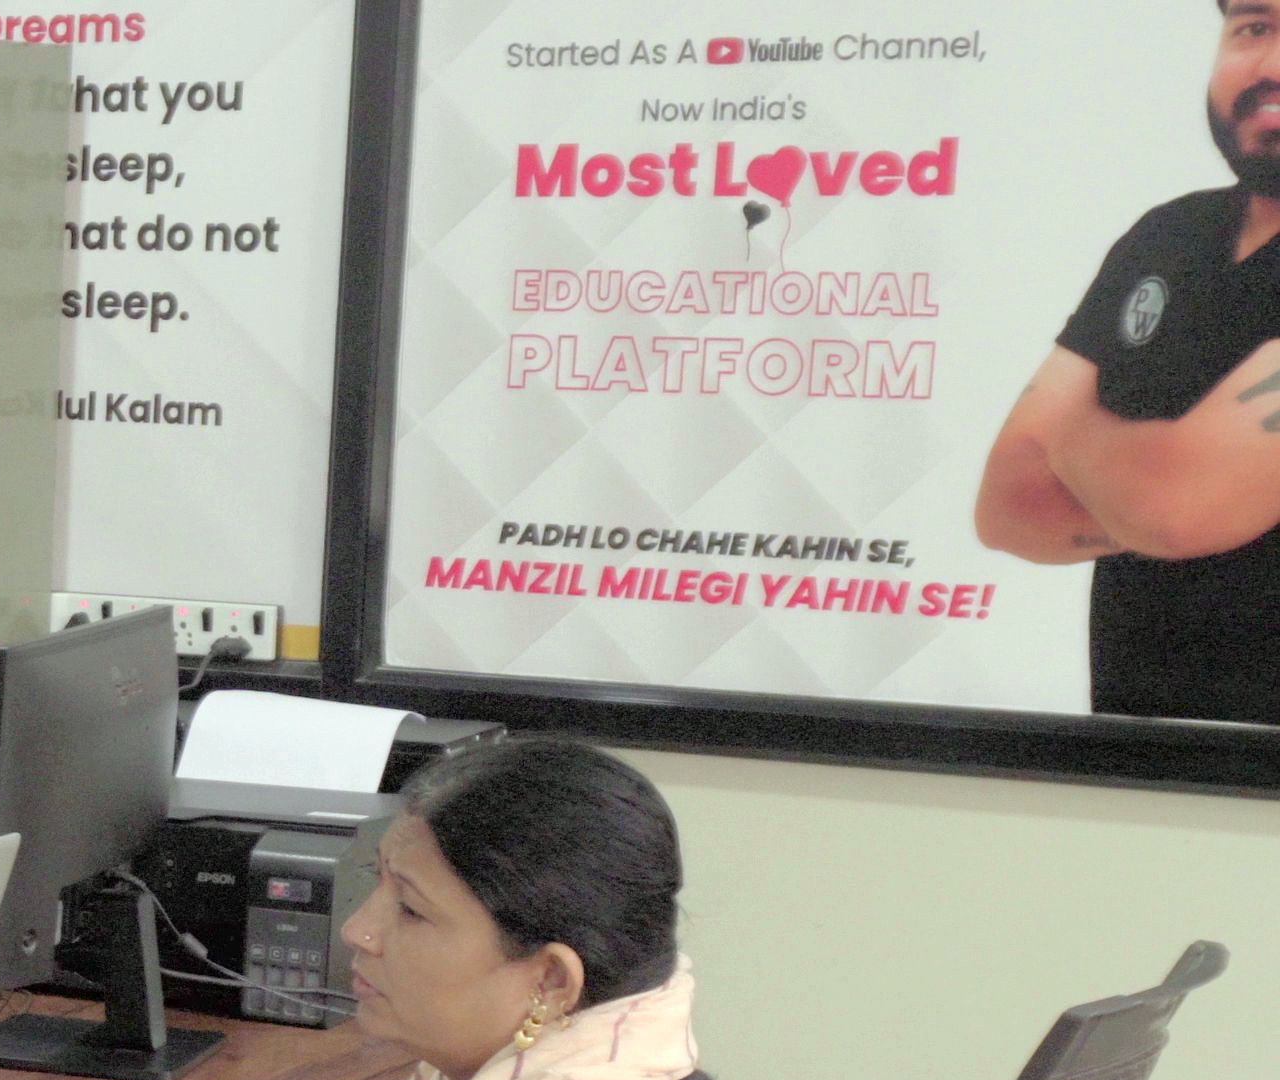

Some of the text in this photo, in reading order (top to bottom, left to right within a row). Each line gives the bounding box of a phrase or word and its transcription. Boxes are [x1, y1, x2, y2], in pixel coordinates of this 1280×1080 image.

[506, 31, 987, 68] Started As A YouTube Channel,
[70, 75, 244, 125] hat you
[641, 93, 807, 122] Now India's
[66, 145, 185, 194] sleep,
[514, 143, 699, 198] Most
[137, 214, 193, 251] do
[205, 216, 280, 252] not
[61, 282, 190, 332] sleep.
[512, 269, 938, 317] EDUCATIONAL
[506, 334, 936, 399] PLATFORM
[105, 393, 223, 426] Kalam
[499, 521, 917, 569] PADH LO CHAHE KAHIN SE,
[425, 556, 997, 620] MANZIL MILEGI YAHIN SE!
[196, 871, 236, 885] EPSON
